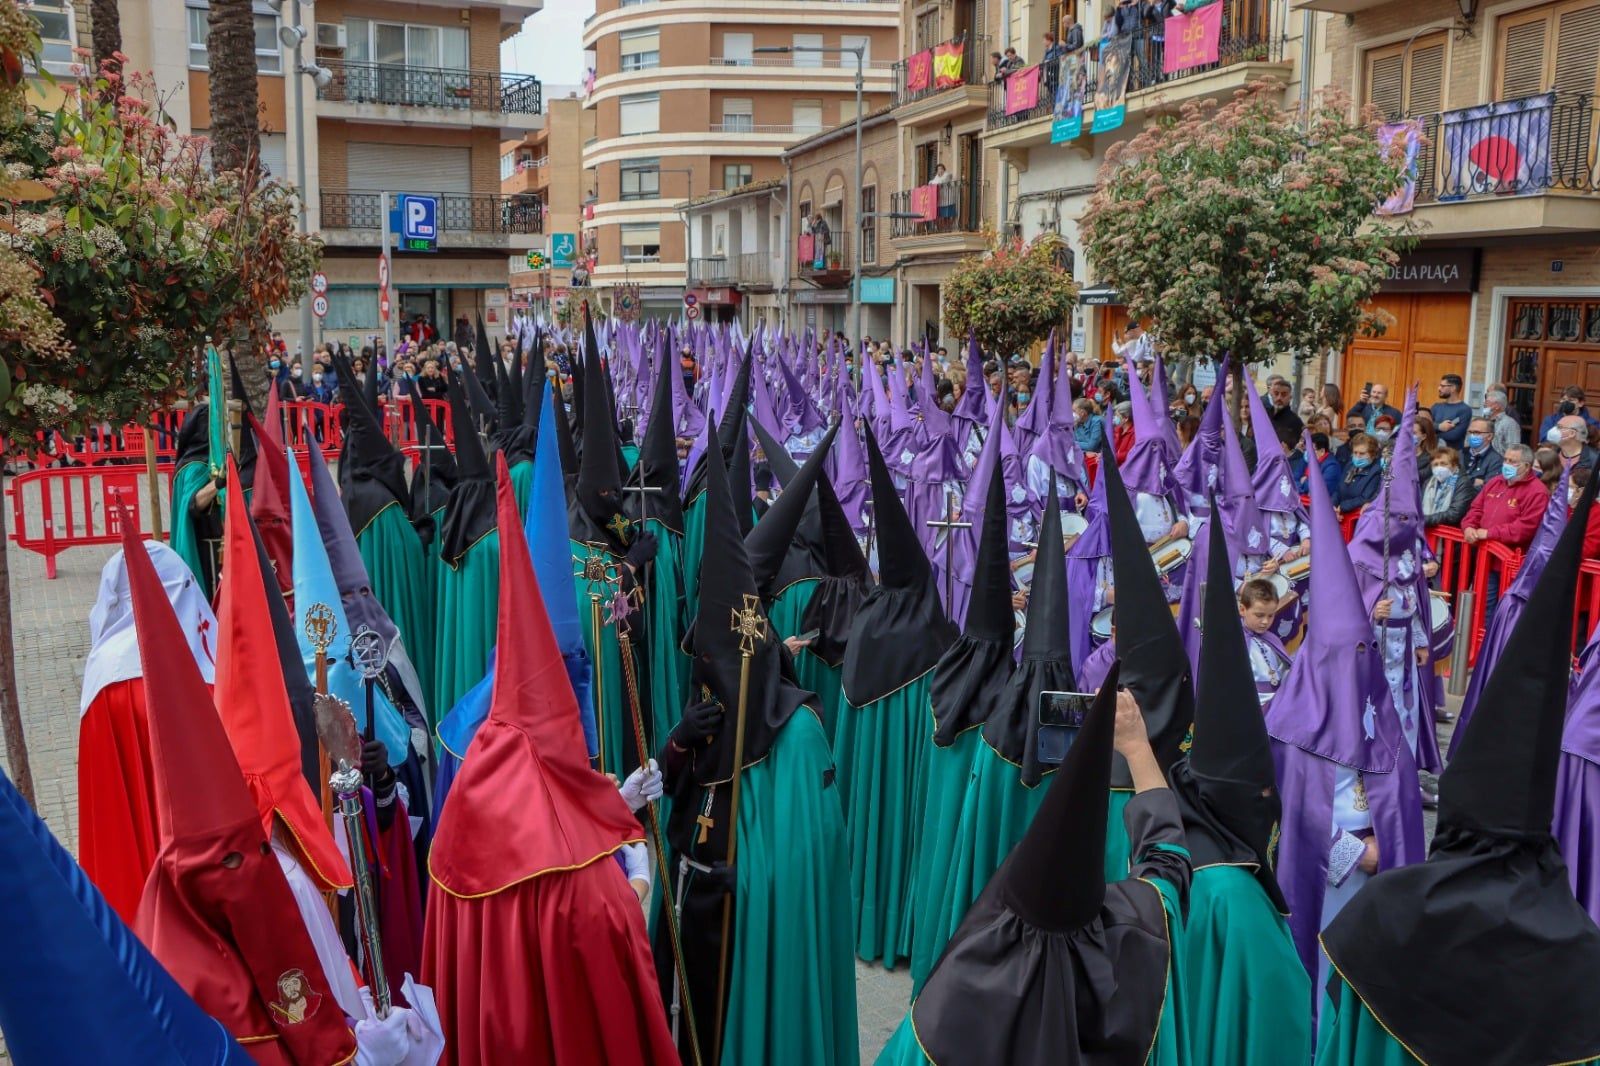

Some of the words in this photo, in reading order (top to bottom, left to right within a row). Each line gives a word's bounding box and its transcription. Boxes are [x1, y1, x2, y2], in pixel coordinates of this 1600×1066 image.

[408, 201, 426, 233] P
[410, 240, 429, 250] LIBRE
[1387, 266, 1401, 280] DE
[1403, 265, 1418, 280] LA
[1420, 265, 1459, 284] PLAÇA
[316, 302, 325, 311] 10
